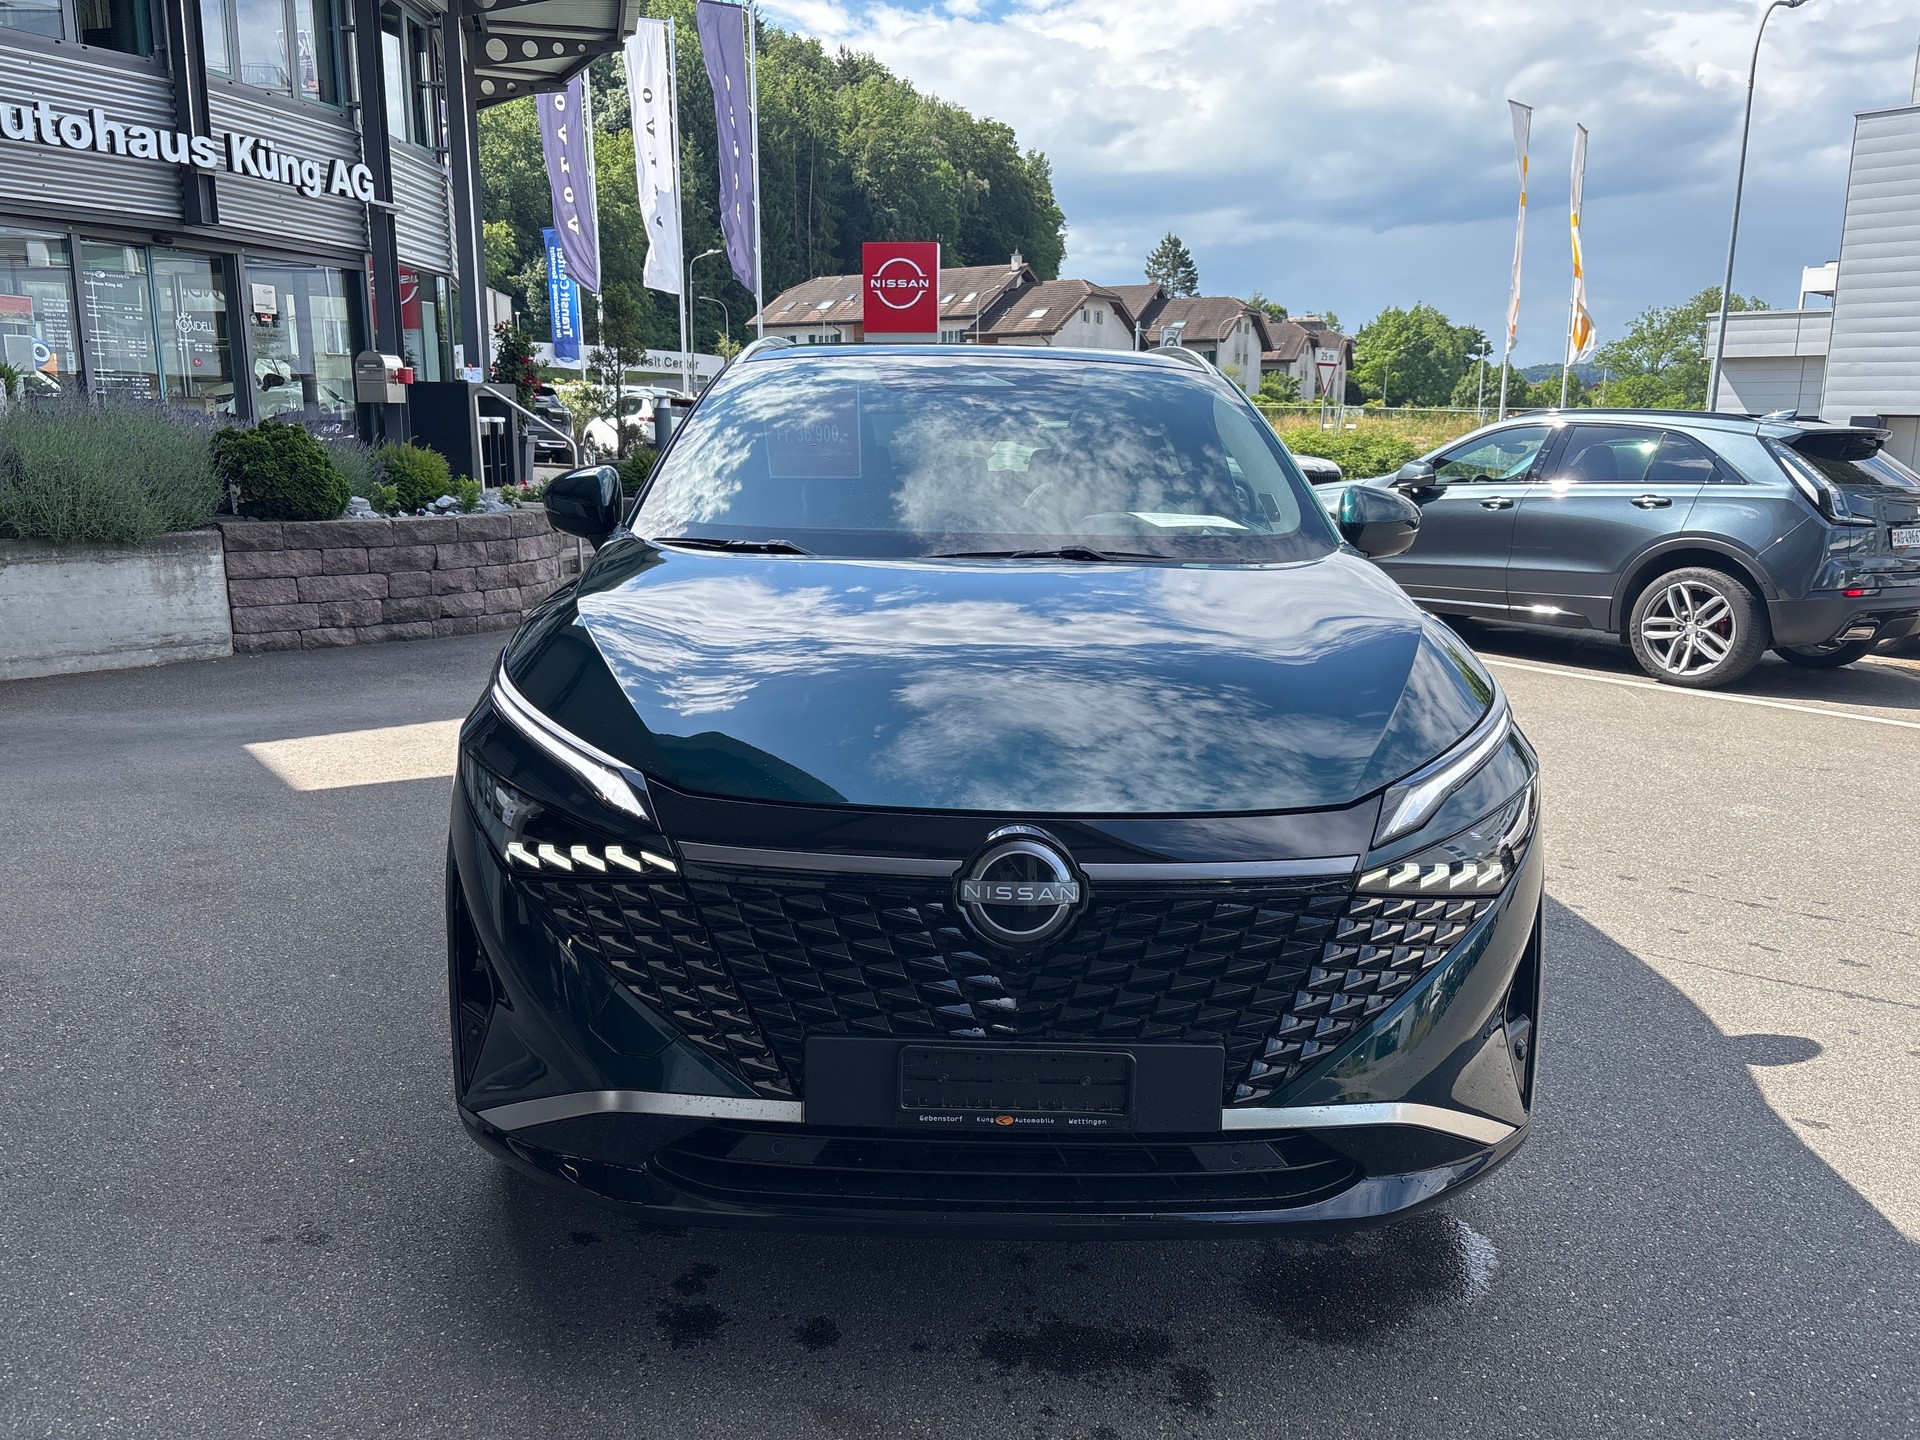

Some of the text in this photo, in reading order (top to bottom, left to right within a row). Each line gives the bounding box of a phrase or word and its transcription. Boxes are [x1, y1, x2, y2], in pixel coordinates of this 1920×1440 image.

[0, 101, 374, 202] utohaus Küng AG
[870, 279, 929, 288] NISSAN
[1321, 352, 1328, 361] 25
[964, 884, 1076, 901] NISSAN
[919, 1115, 963, 1123] Gebenstorf
[1068, 1118, 1107, 1126] Wettingen
